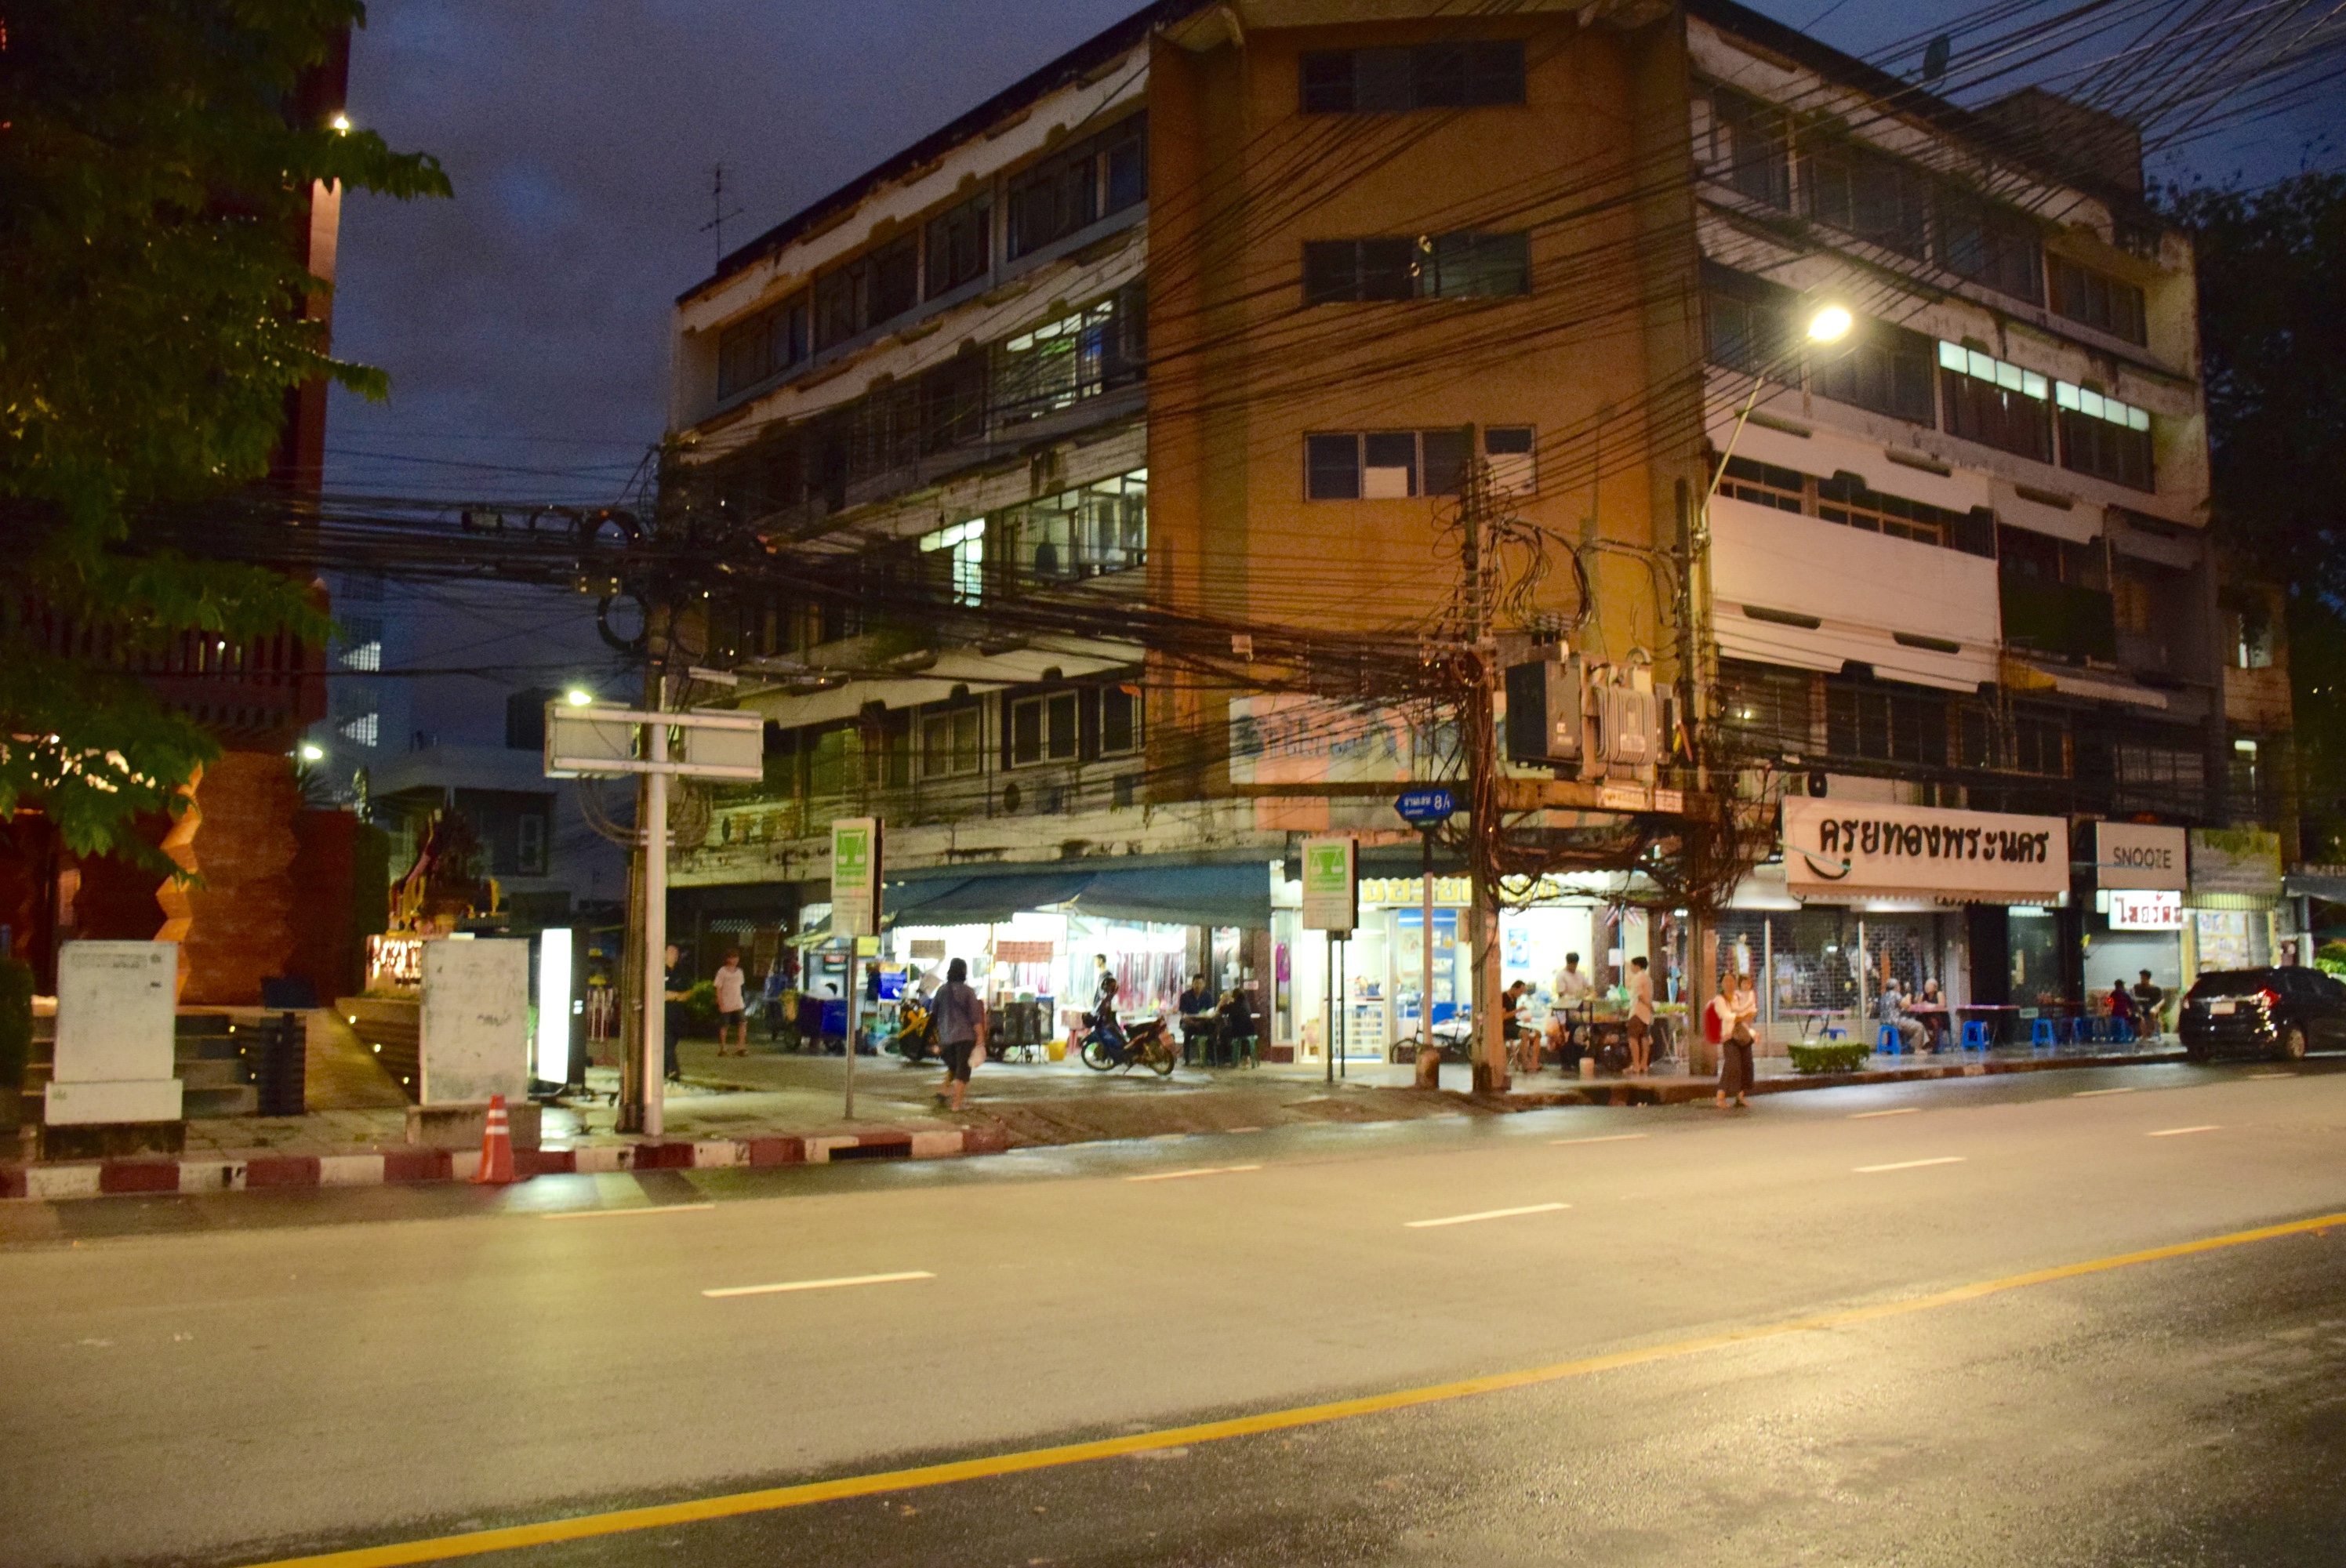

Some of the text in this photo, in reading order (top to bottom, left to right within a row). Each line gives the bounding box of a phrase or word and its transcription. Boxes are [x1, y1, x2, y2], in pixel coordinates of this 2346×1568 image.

[1806, 818, 2050, 879] ครุยทองพระนคร
[2112, 846, 2171, 869] SNOOZE
